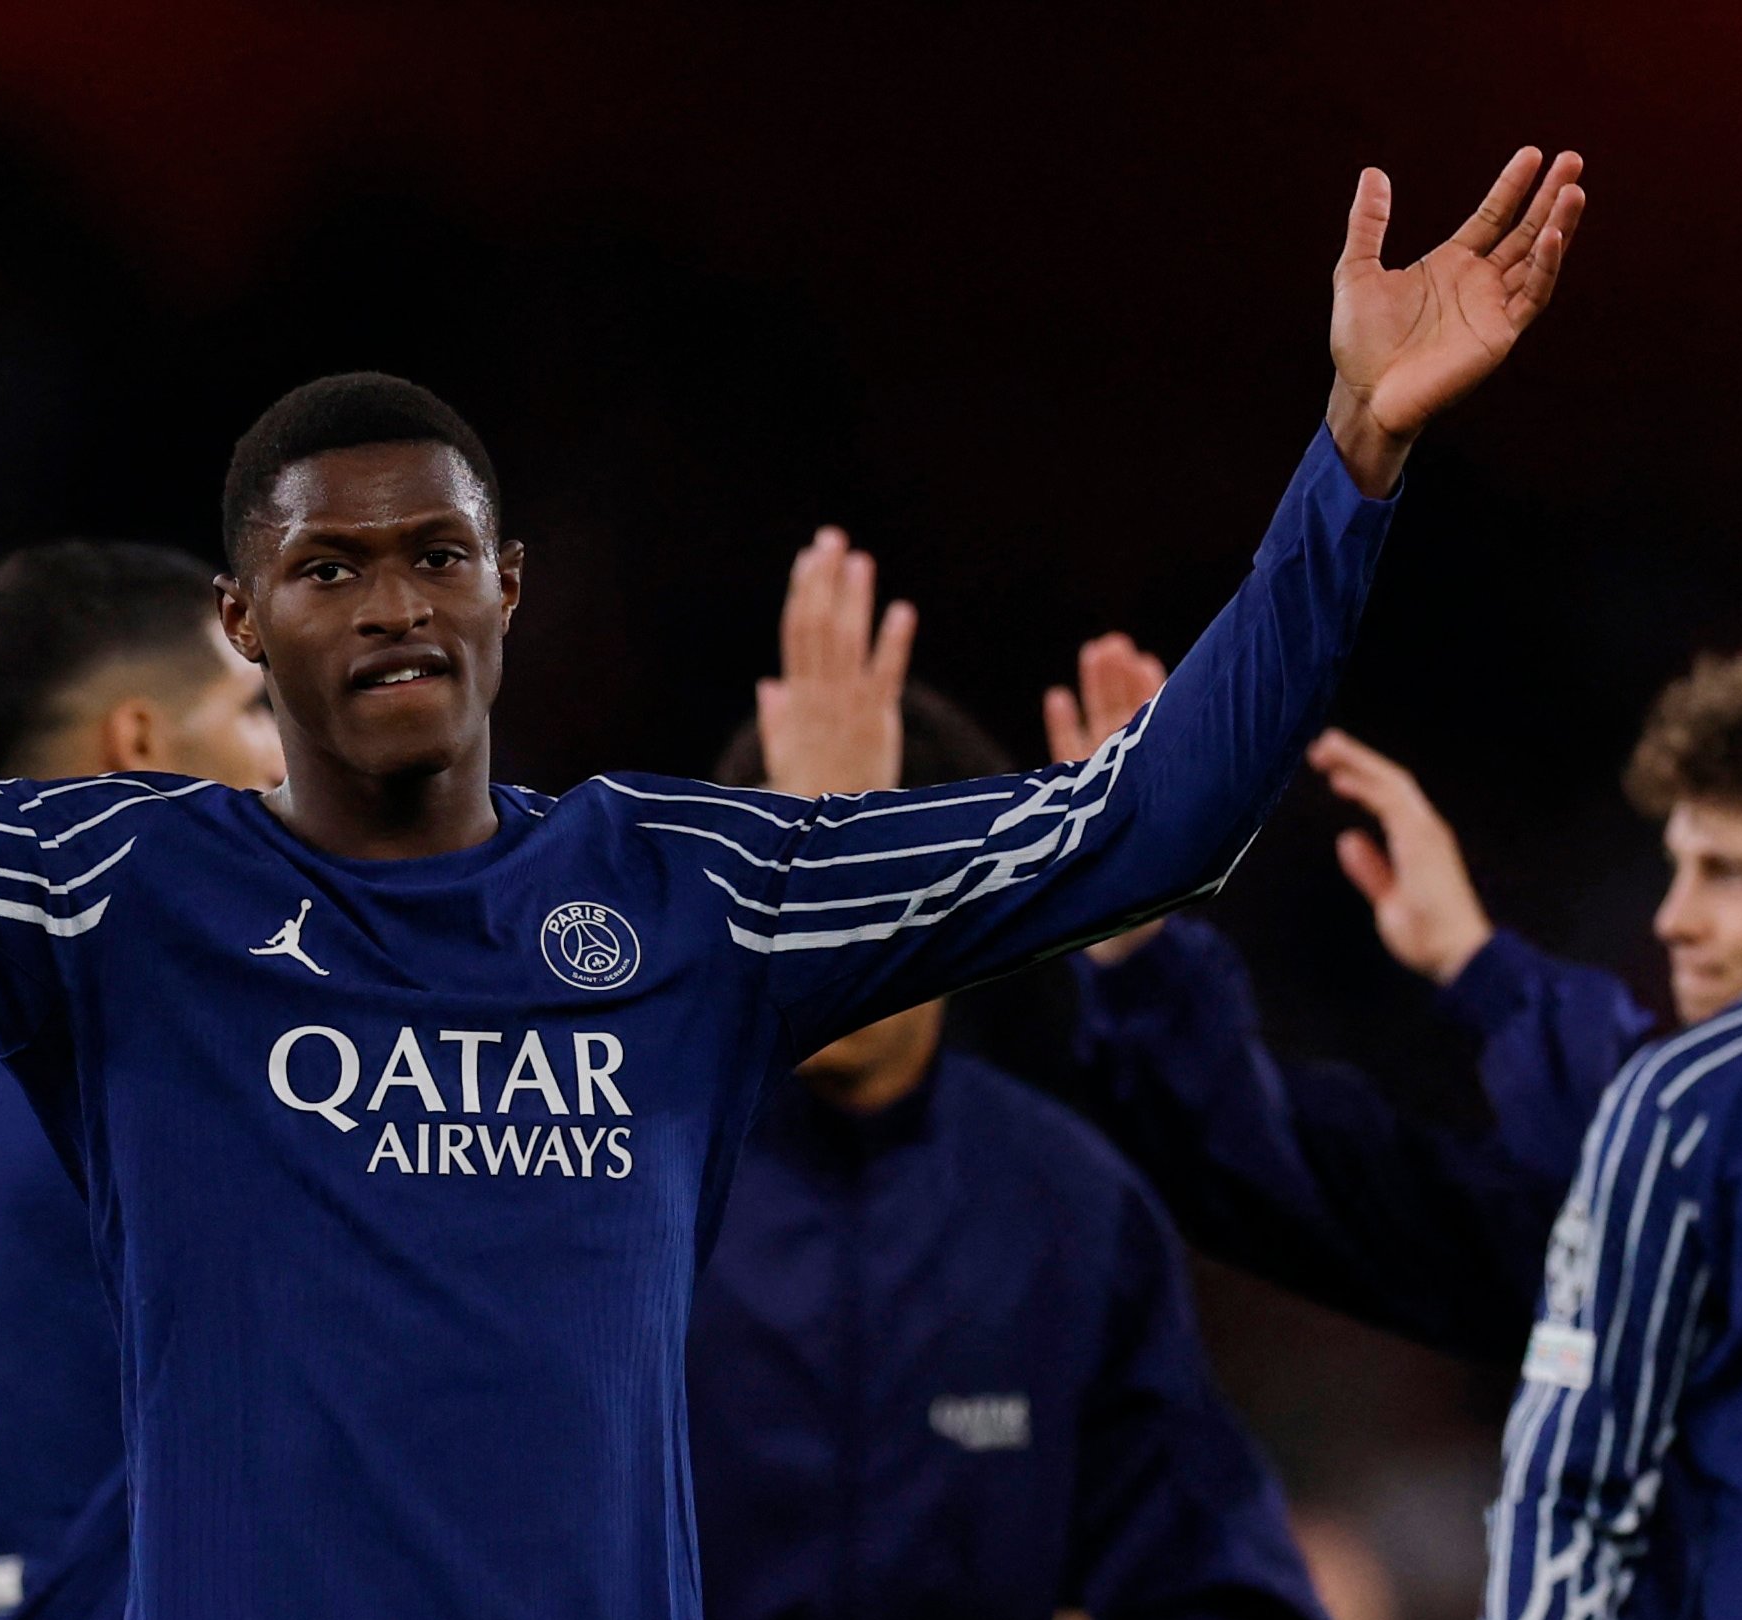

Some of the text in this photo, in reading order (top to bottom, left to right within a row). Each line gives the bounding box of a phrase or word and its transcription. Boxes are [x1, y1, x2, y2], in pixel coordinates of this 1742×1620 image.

[547, 906, 607, 935] PARIS
[268, 1025, 633, 1133] QATAR
[366, 1123, 634, 1179] AIRWAYS
